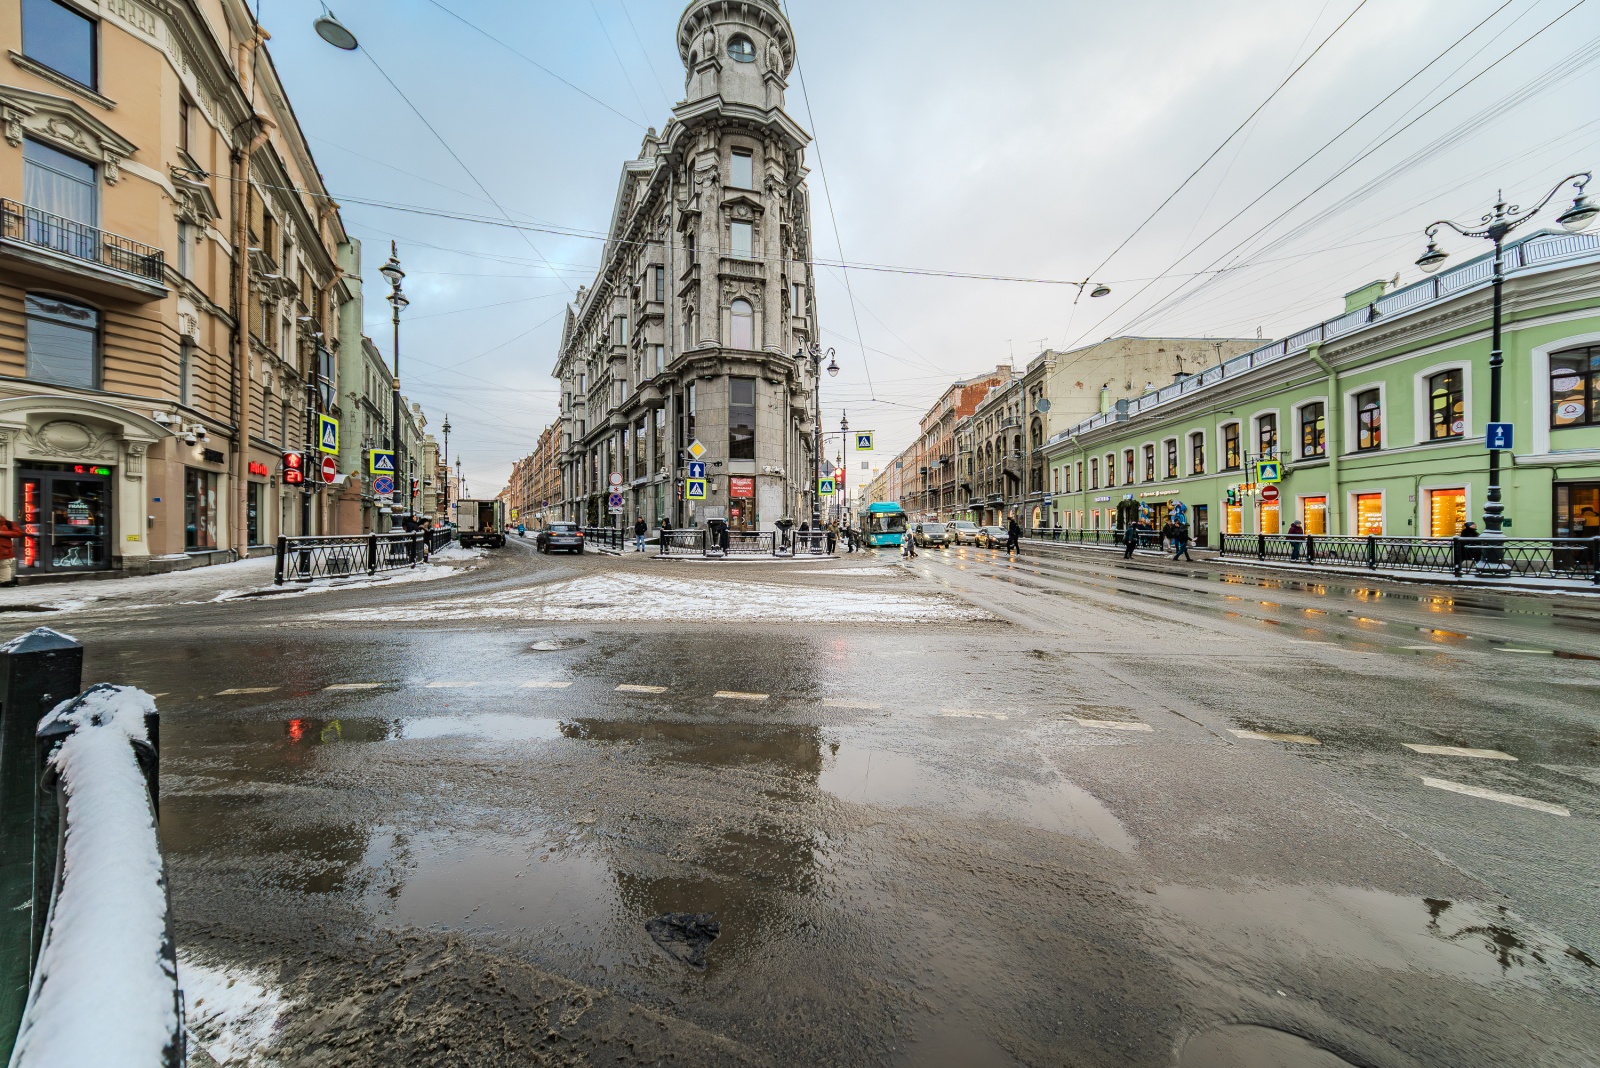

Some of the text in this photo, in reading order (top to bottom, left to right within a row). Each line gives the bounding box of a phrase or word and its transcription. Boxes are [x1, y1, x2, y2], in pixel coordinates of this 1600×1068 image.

[287, 471, 302, 482] 27
[25, 483, 34, 565] ribs & bar
